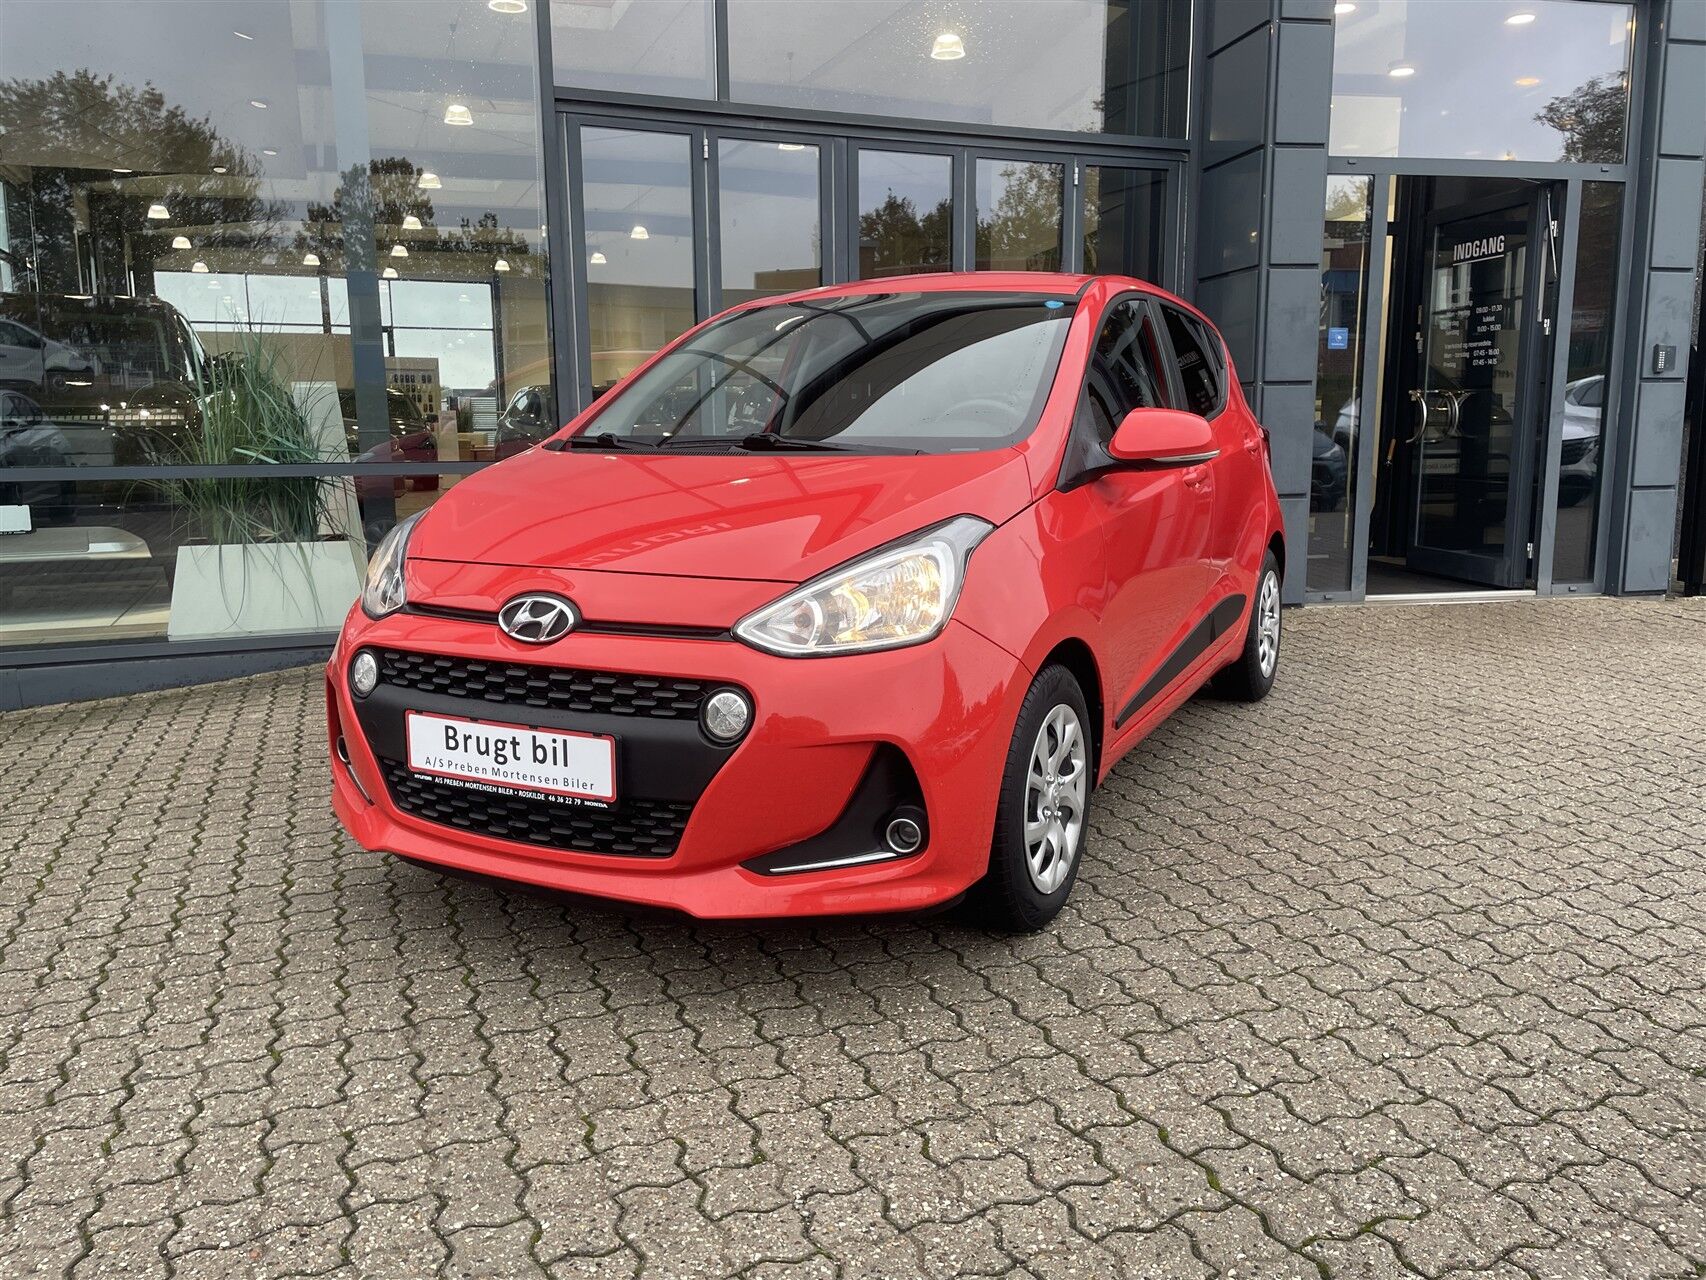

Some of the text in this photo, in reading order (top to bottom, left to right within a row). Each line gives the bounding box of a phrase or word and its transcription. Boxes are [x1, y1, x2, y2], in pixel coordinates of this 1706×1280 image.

[1453, 235, 1505, 261] INDGANG
[444, 724, 569, 767] Brugt bil
[425, 756, 594, 791] A/S Preben Mortensen Biler
[435, 776, 443, 784] A/S
[444, 778, 464, 787] PREBEN
[465, 781, 497, 793] MORTENSEN
[498, 787, 514, 796] BILER
[518, 790, 545, 801] ROSKILDE
[548, 794, 556, 802] 46
[565, 797, 573, 805] 22
[574, 798, 581, 806] 79
[584, 800, 608, 809] HONDA
